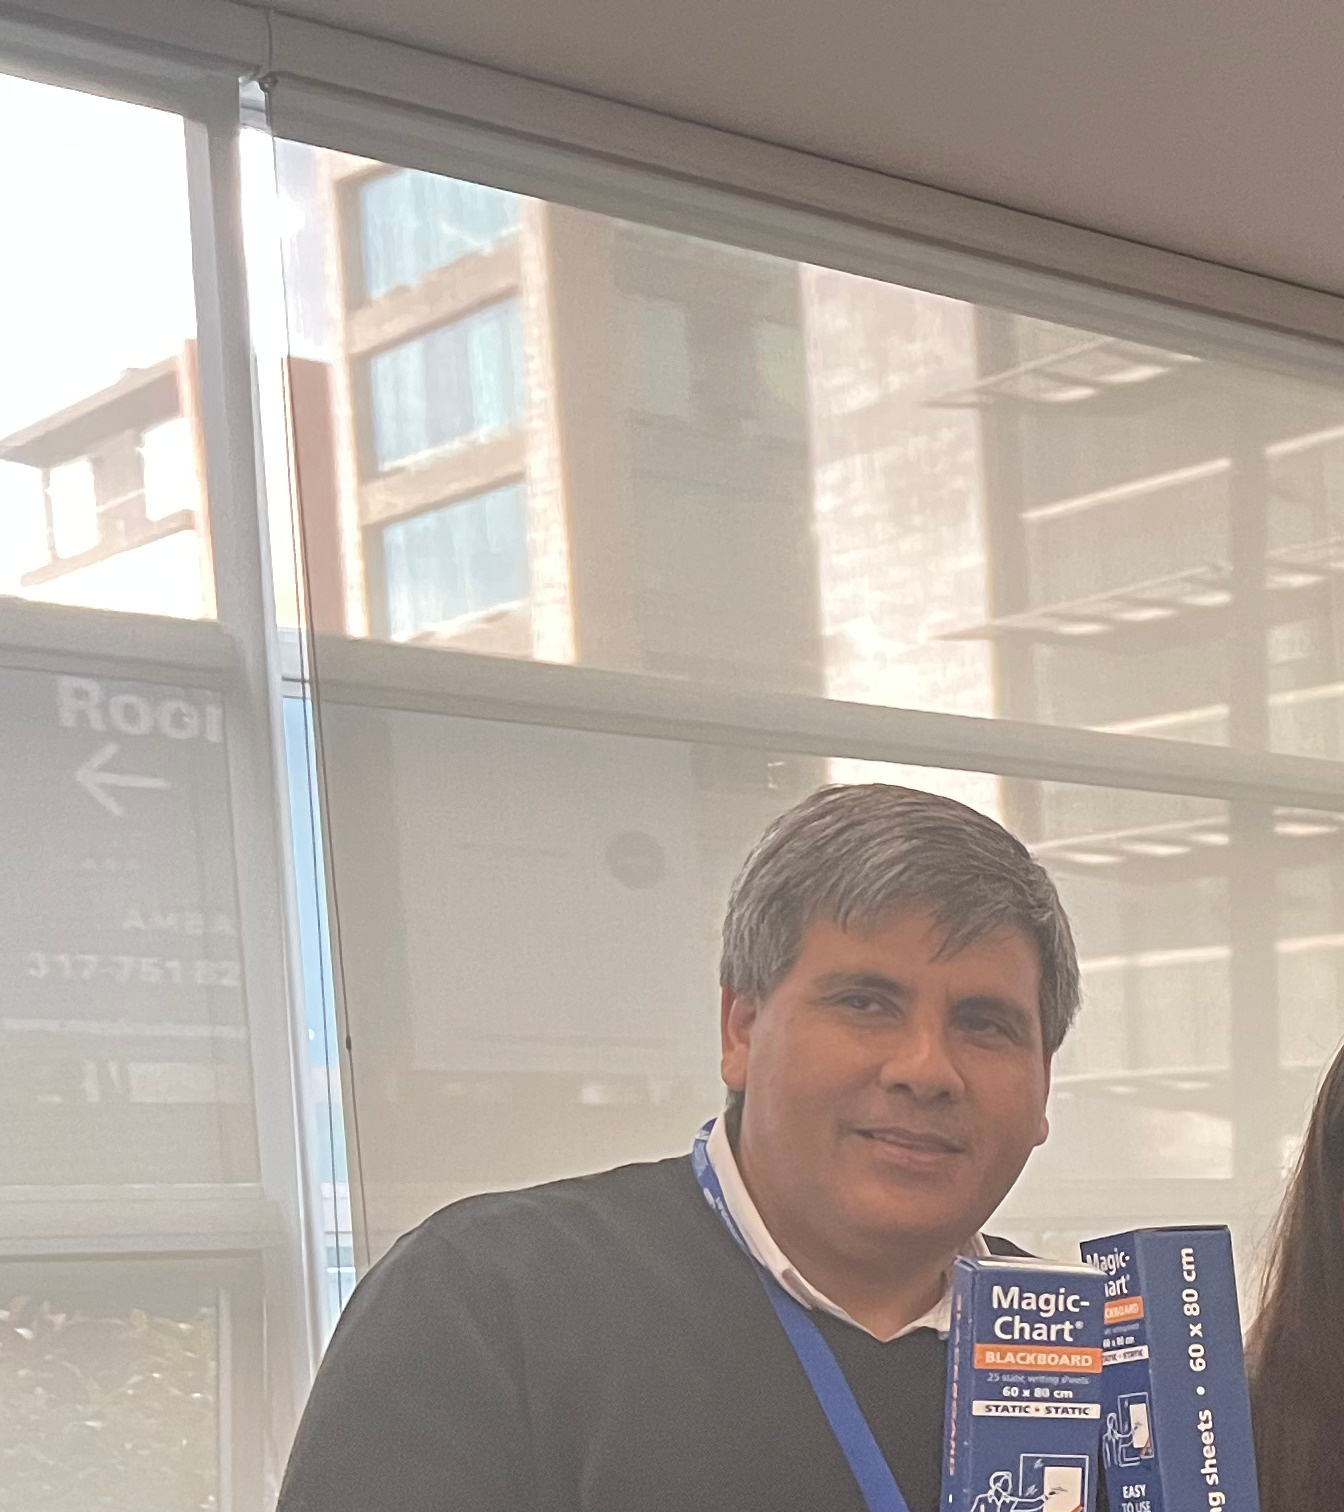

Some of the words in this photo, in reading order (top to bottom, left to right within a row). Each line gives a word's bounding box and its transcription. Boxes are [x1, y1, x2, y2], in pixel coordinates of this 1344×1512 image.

[57, 674, 224, 743] Roo
[1181, 1247, 1197, 1282] cm
[992, 1285, 1091, 1318] Magic-
[1181, 1288, 1200, 1316] 80
[1189, 1322, 1203, 1338] x
[985, 1351, 1093, 1367] BLACKBOARD
[1188, 1343, 1206, 1372] 60
[1002, 1386, 1019, 1397] 60
[1022, 1388, 1030, 1397] x
[1033, 1387, 1050, 1398] 80
[1053, 1389, 1074, 1399] cm
[985, 1404, 1031, 1414] STATIC
[1045, 1405, 1090, 1416] STATIC
[1197, 1409, 1220, 1486] sheets
[1122, 1484, 1146, 1499] EASY
